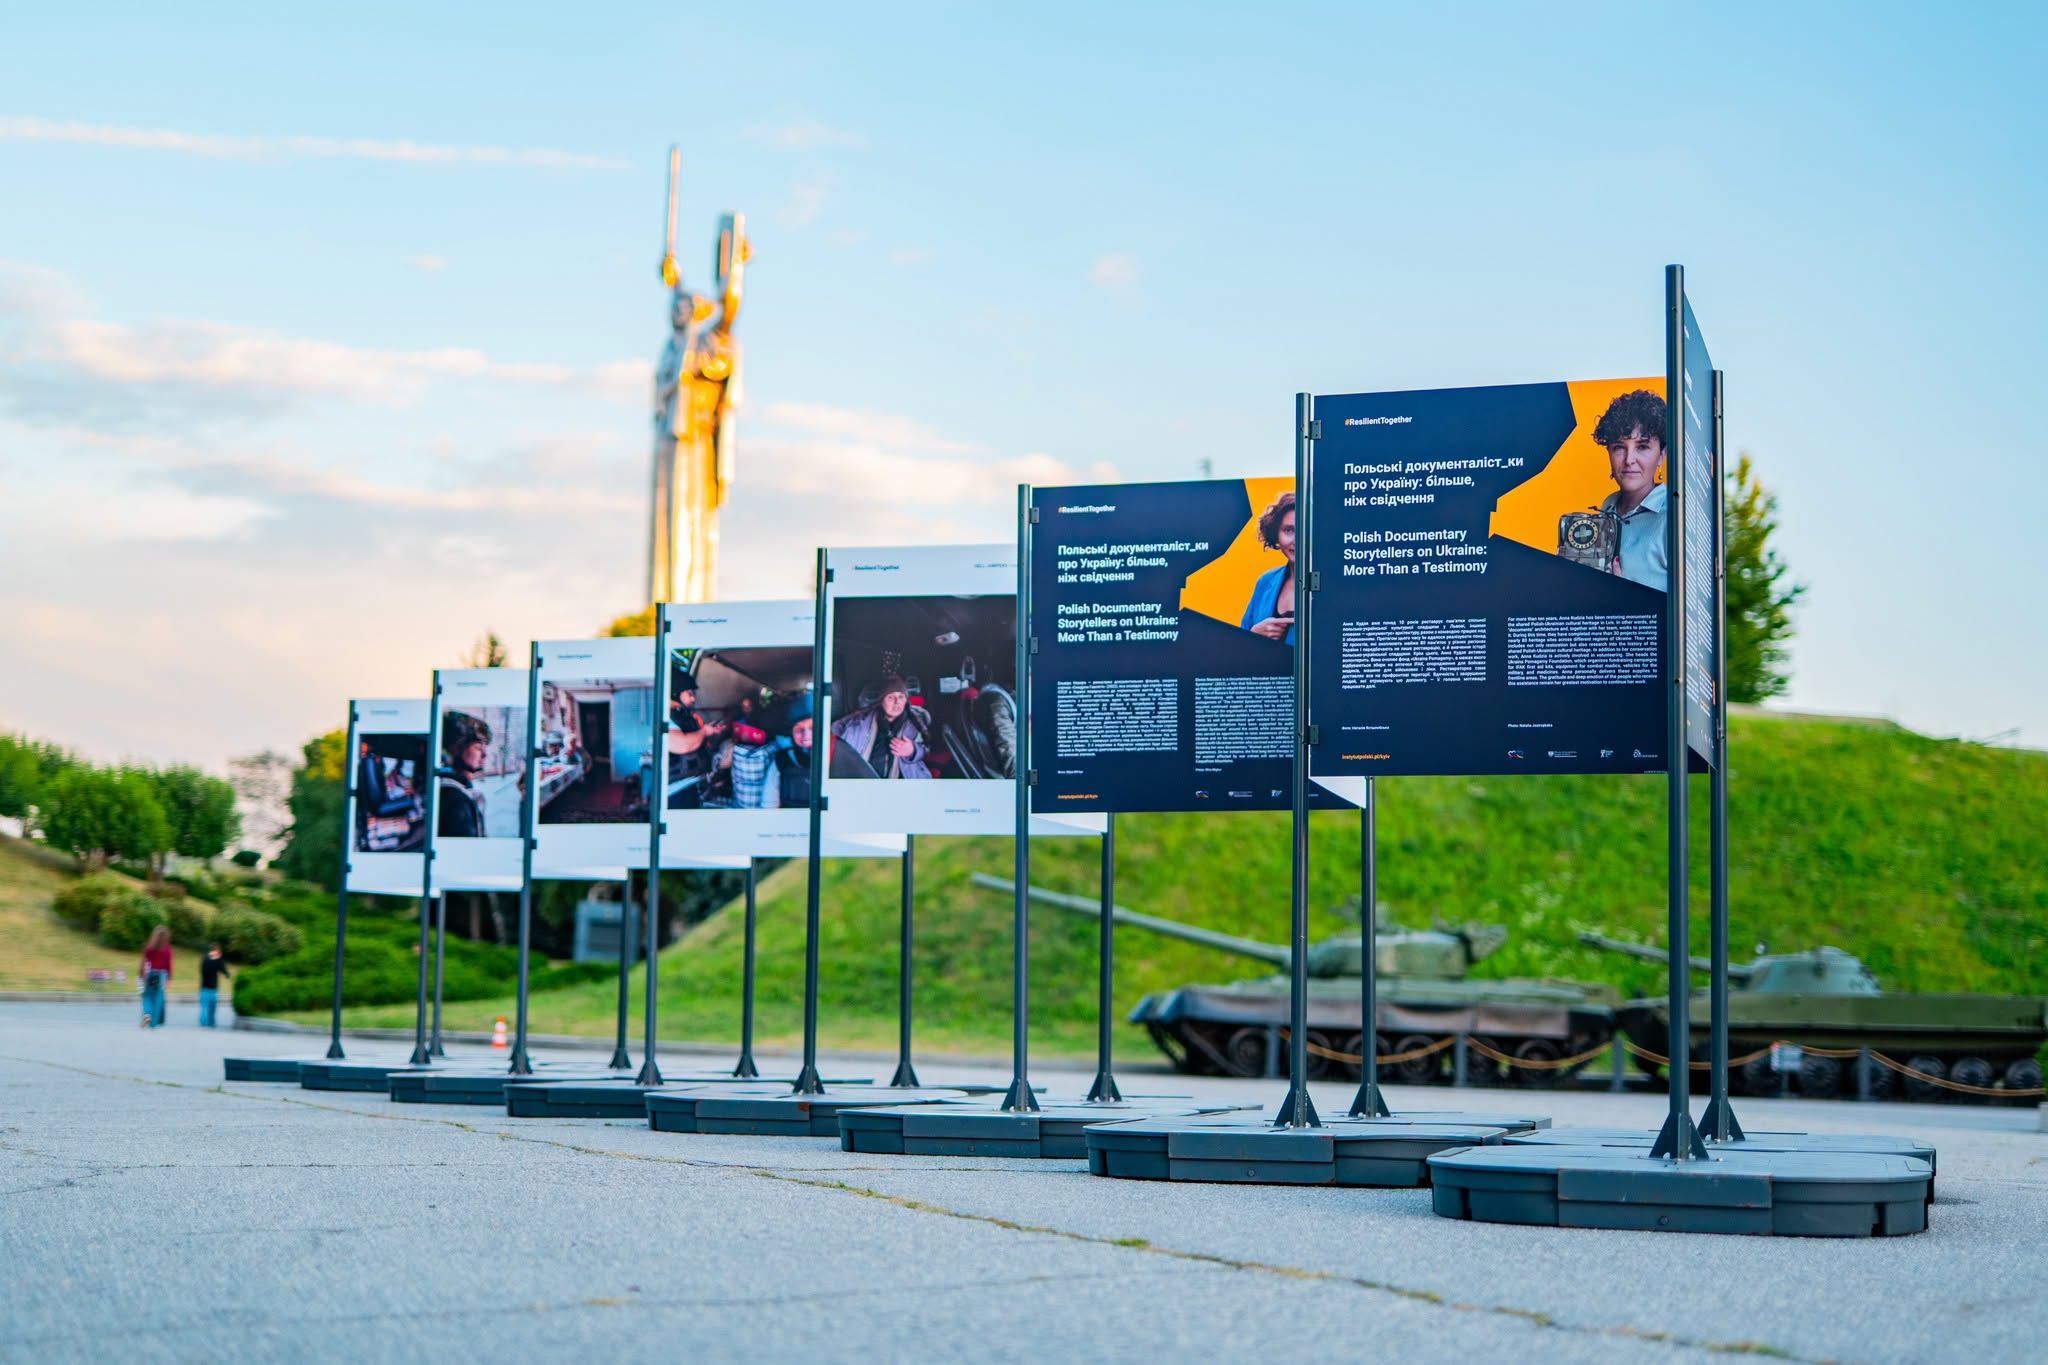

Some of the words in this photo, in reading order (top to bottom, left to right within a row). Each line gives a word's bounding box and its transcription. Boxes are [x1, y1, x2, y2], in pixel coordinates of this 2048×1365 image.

[1345, 416, 1412, 426] #ResilientTogether
[1344, 461, 1402, 475] Польські
[1405, 457, 1524, 474] документаліст_ки
[1344, 480, 1367, 492] про
[1371, 478, 1423, 491] Україну:
[1426, 476, 1475, 487] більше,
[1344, 496, 1366, 507] ніж
[1370, 494, 1435, 507] свідчення
[1058, 505, 1116, 513] #ResilientTogether
[1344, 531, 1382, 544] Polish
[1384, 530, 1467, 542] Documentary
[1058, 544, 1107, 556] Польські
[1109, 541, 1209, 555] документаліст_ки
[1344, 547, 1414, 561] Storytellers
[1417, 548, 1432, 557] on
[1436, 544, 1487, 556] Ukraine:
[1058, 560, 1078, 571] про
[1080, 558, 1125, 570] Україну:
[1127, 556, 1169, 567] більше,
[1344, 565, 1375, 576] More
[1378, 563, 1408, 575] Than
[1412, 566, 1419, 574] a
[1422, 561, 1488, 574] Testimony
[1058, 574, 1077, 583] ніж
[1080, 572, 1135, 584] свідчення
[1058, 604, 1090, 615] Polish
[1093, 603, 1162, 614] Documentary
[1058, 618, 1117, 630] Storytellers
[1120, 618, 1133, 626] on
[1135, 616, 1178, 625] Ukraine:
[1058, 633, 1085, 642] More
[1087, 632, 1113, 642] Than
[1124, 630, 1179, 641] Testimony
